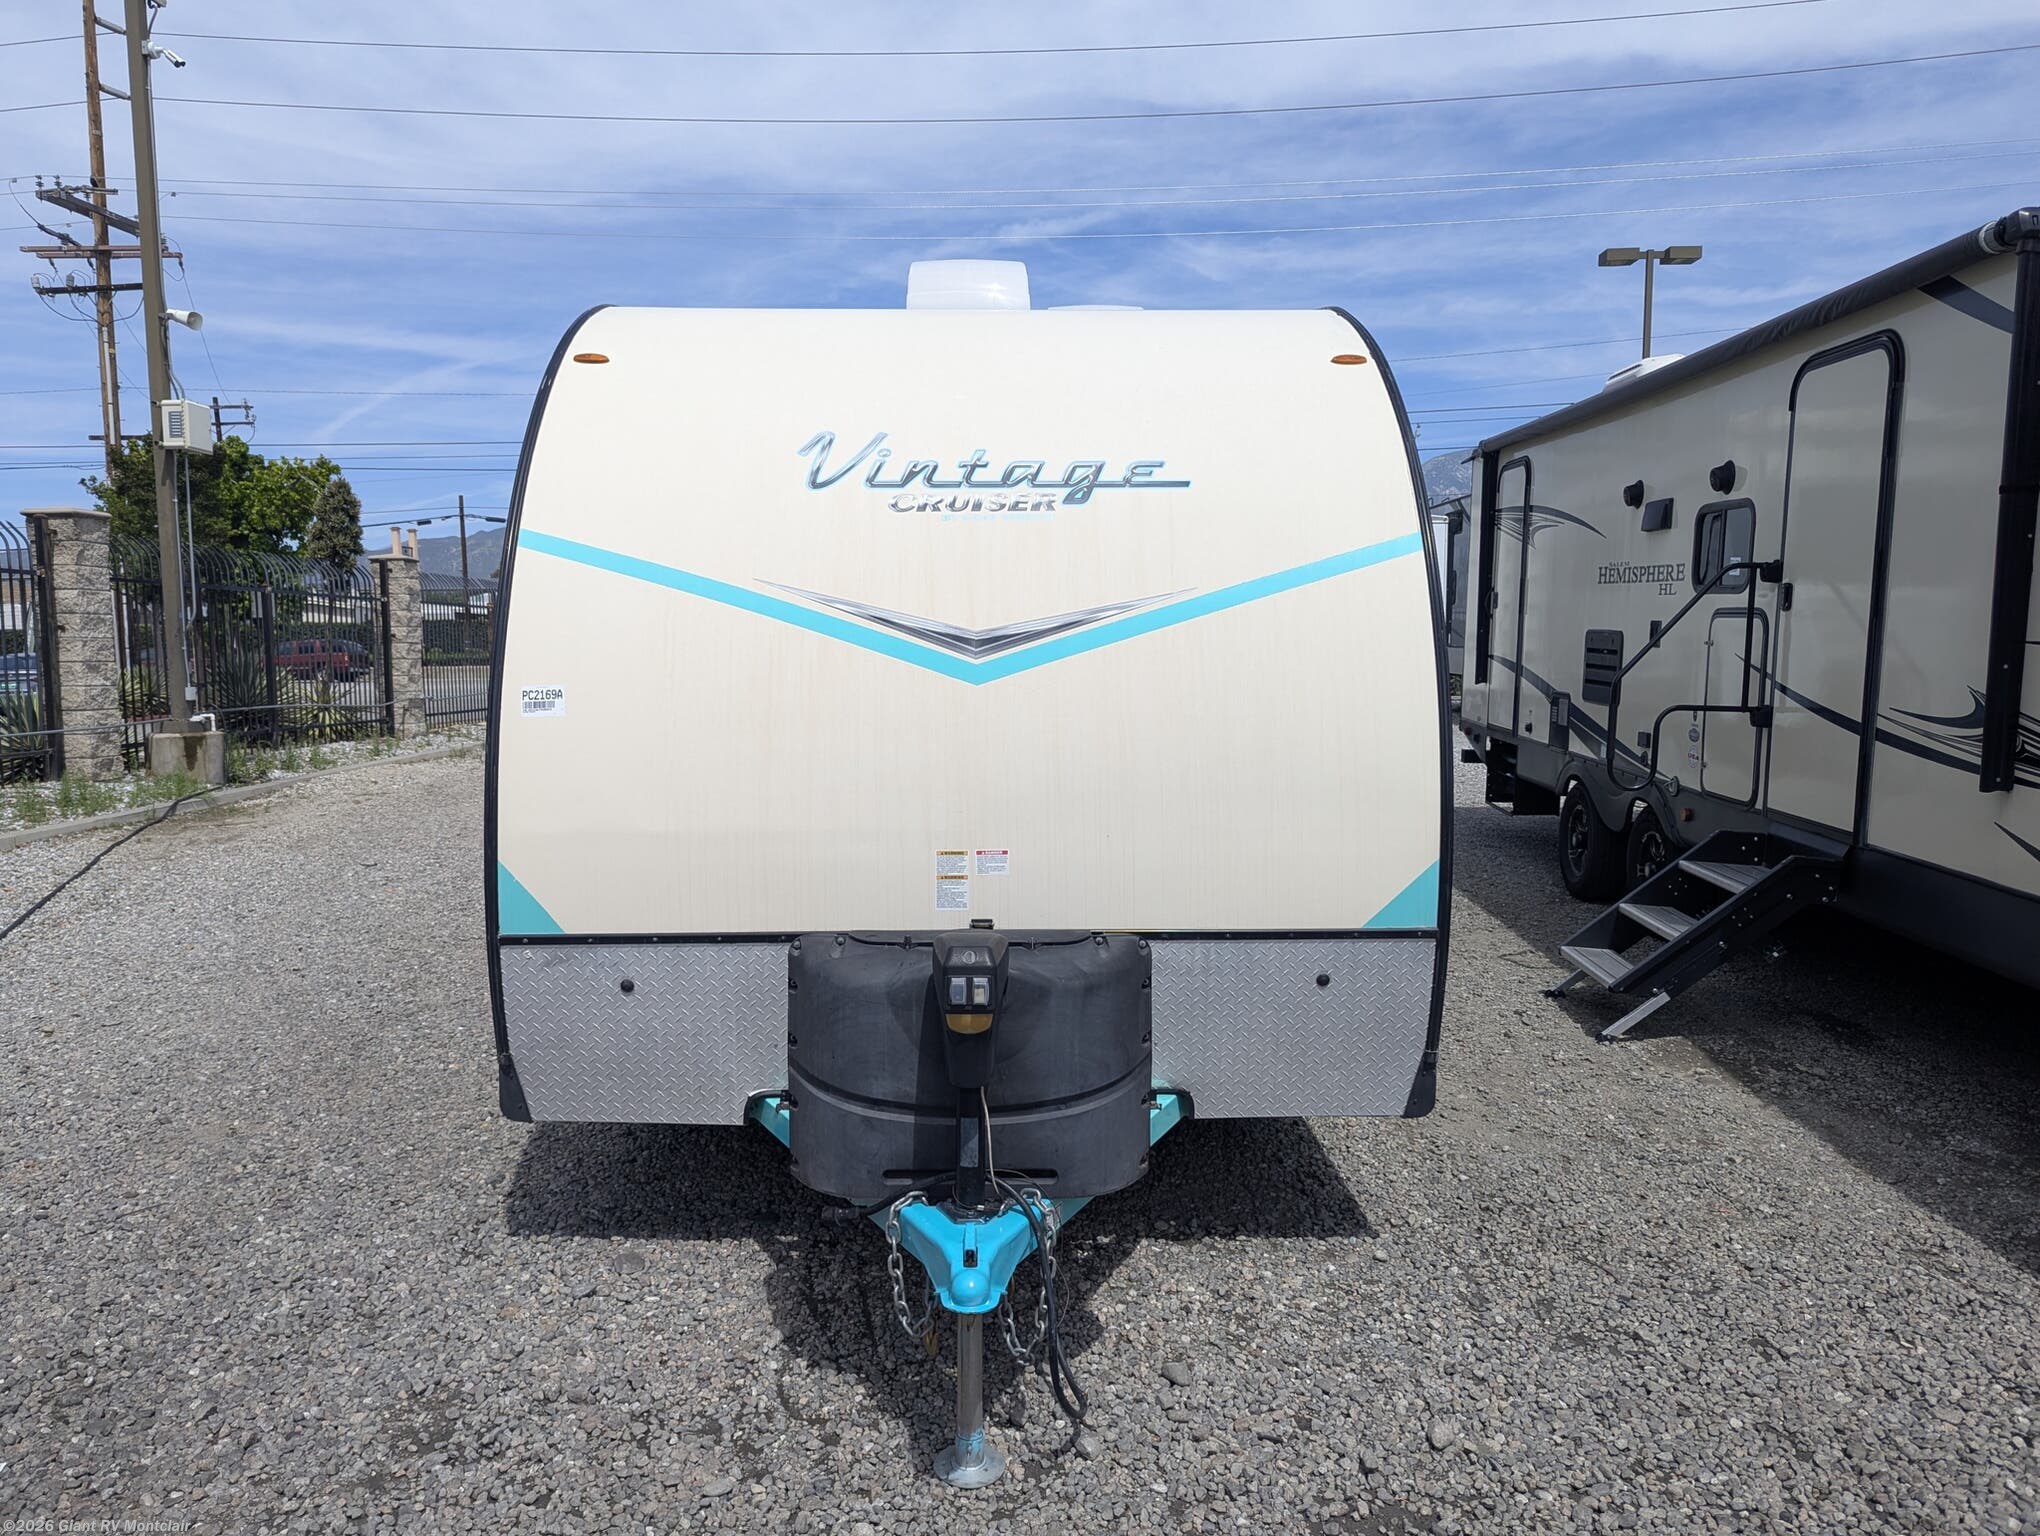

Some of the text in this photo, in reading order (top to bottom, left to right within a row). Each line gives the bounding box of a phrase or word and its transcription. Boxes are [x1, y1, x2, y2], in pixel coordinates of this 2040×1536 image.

[797, 431, 1190, 505] Vintage
[888, 493, 1057, 512] CRUISER
[1598, 563, 1686, 584] HEMISPHERE
[1658, 583, 1677, 595] HL
[522, 689, 563, 700] PC2169A
